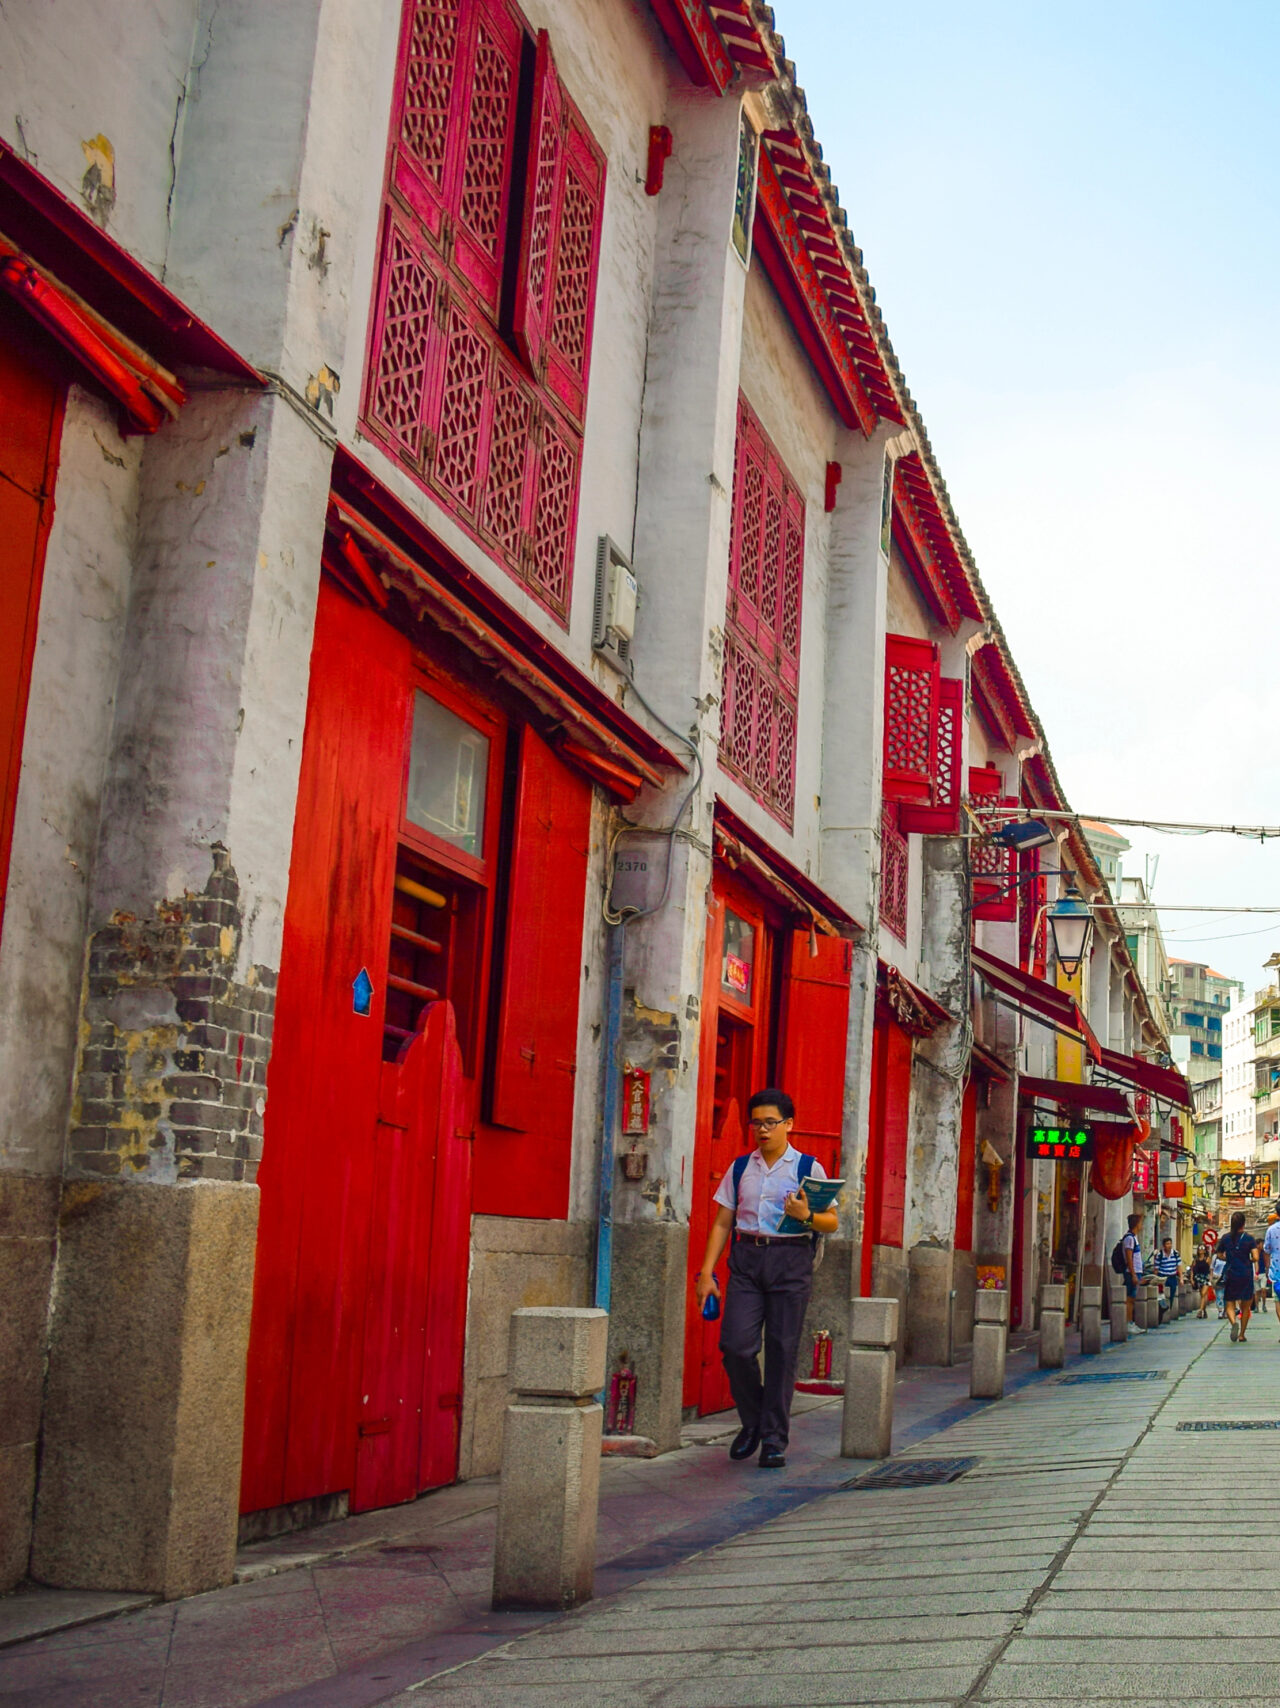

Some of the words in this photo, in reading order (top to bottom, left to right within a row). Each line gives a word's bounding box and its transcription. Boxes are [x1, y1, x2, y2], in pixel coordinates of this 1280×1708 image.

[617, 861, 647, 872] 2370
[630, 1080, 645, 1129] 天官賜福
[1221, 1174, 1254, 1193] 鉅記
